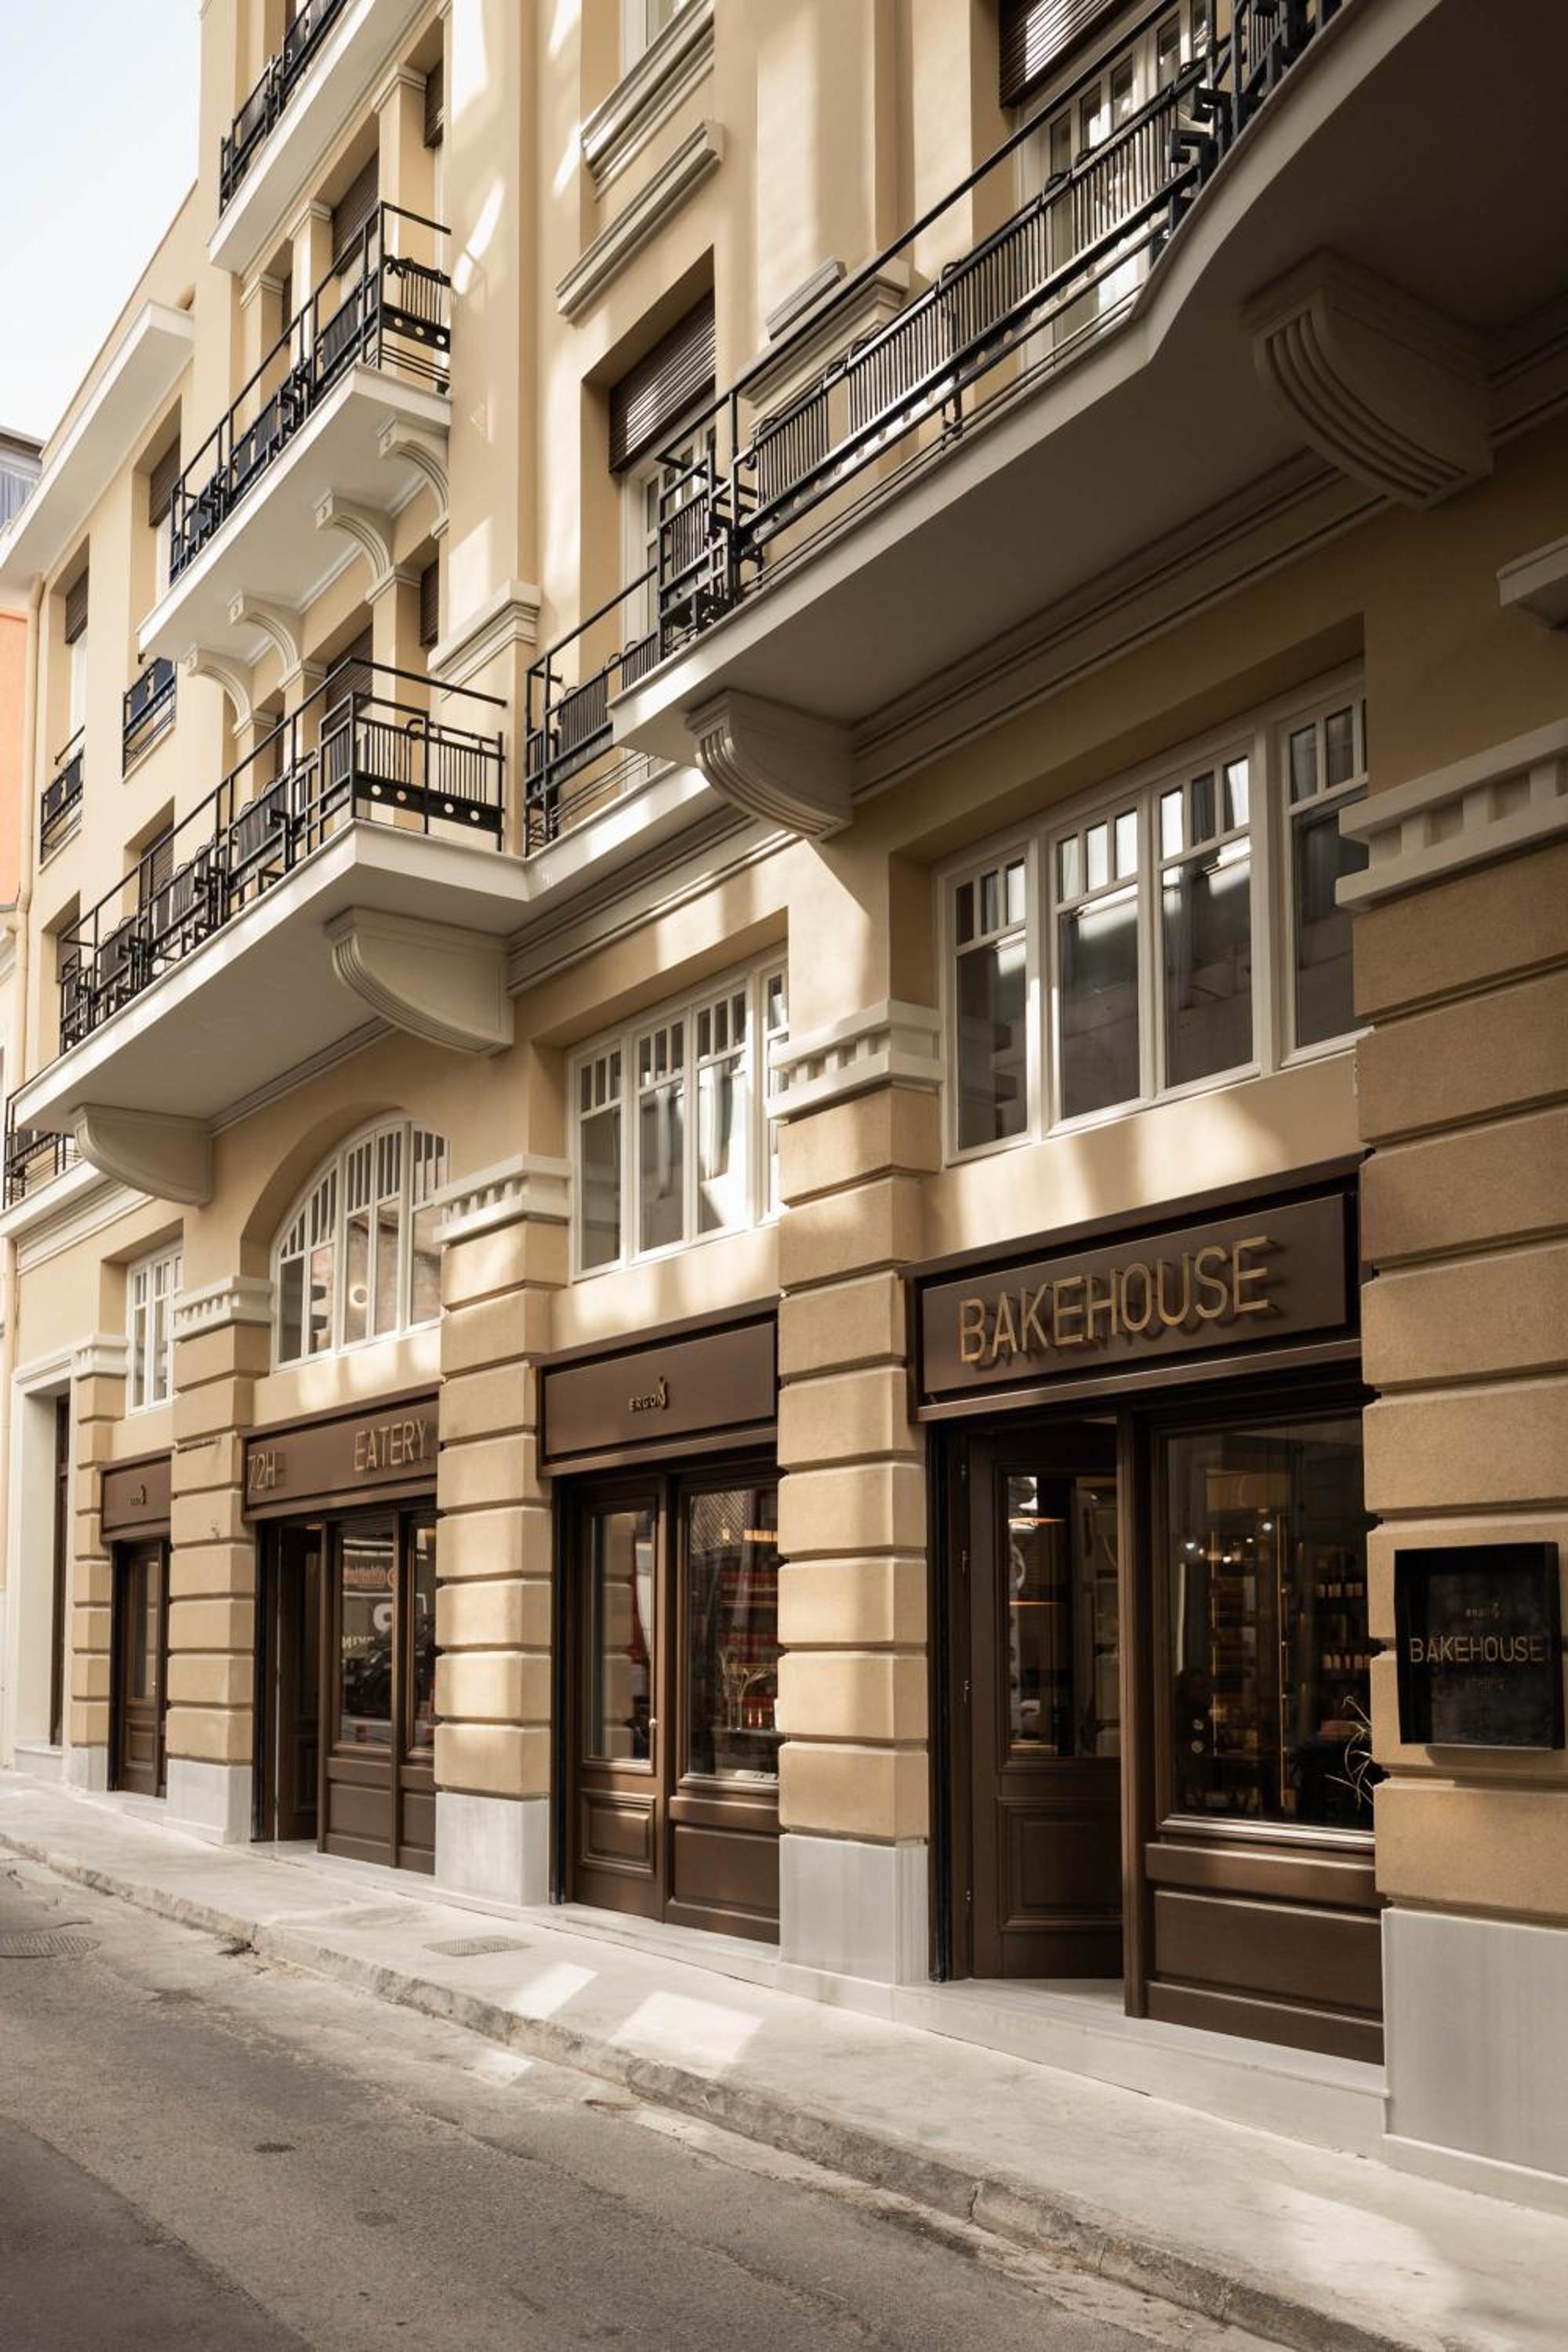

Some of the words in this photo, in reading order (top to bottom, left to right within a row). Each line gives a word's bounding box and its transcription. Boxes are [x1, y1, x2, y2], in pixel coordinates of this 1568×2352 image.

[958, 1235, 1269, 1363] BAKEHOUSE
[628, 1381, 666, 1410] ERGON
[248, 1450, 275, 1490] 72H
[354, 1419, 427, 1472] EATERY
[1408, 1635, 1544, 1663] BAKEHOUSE
